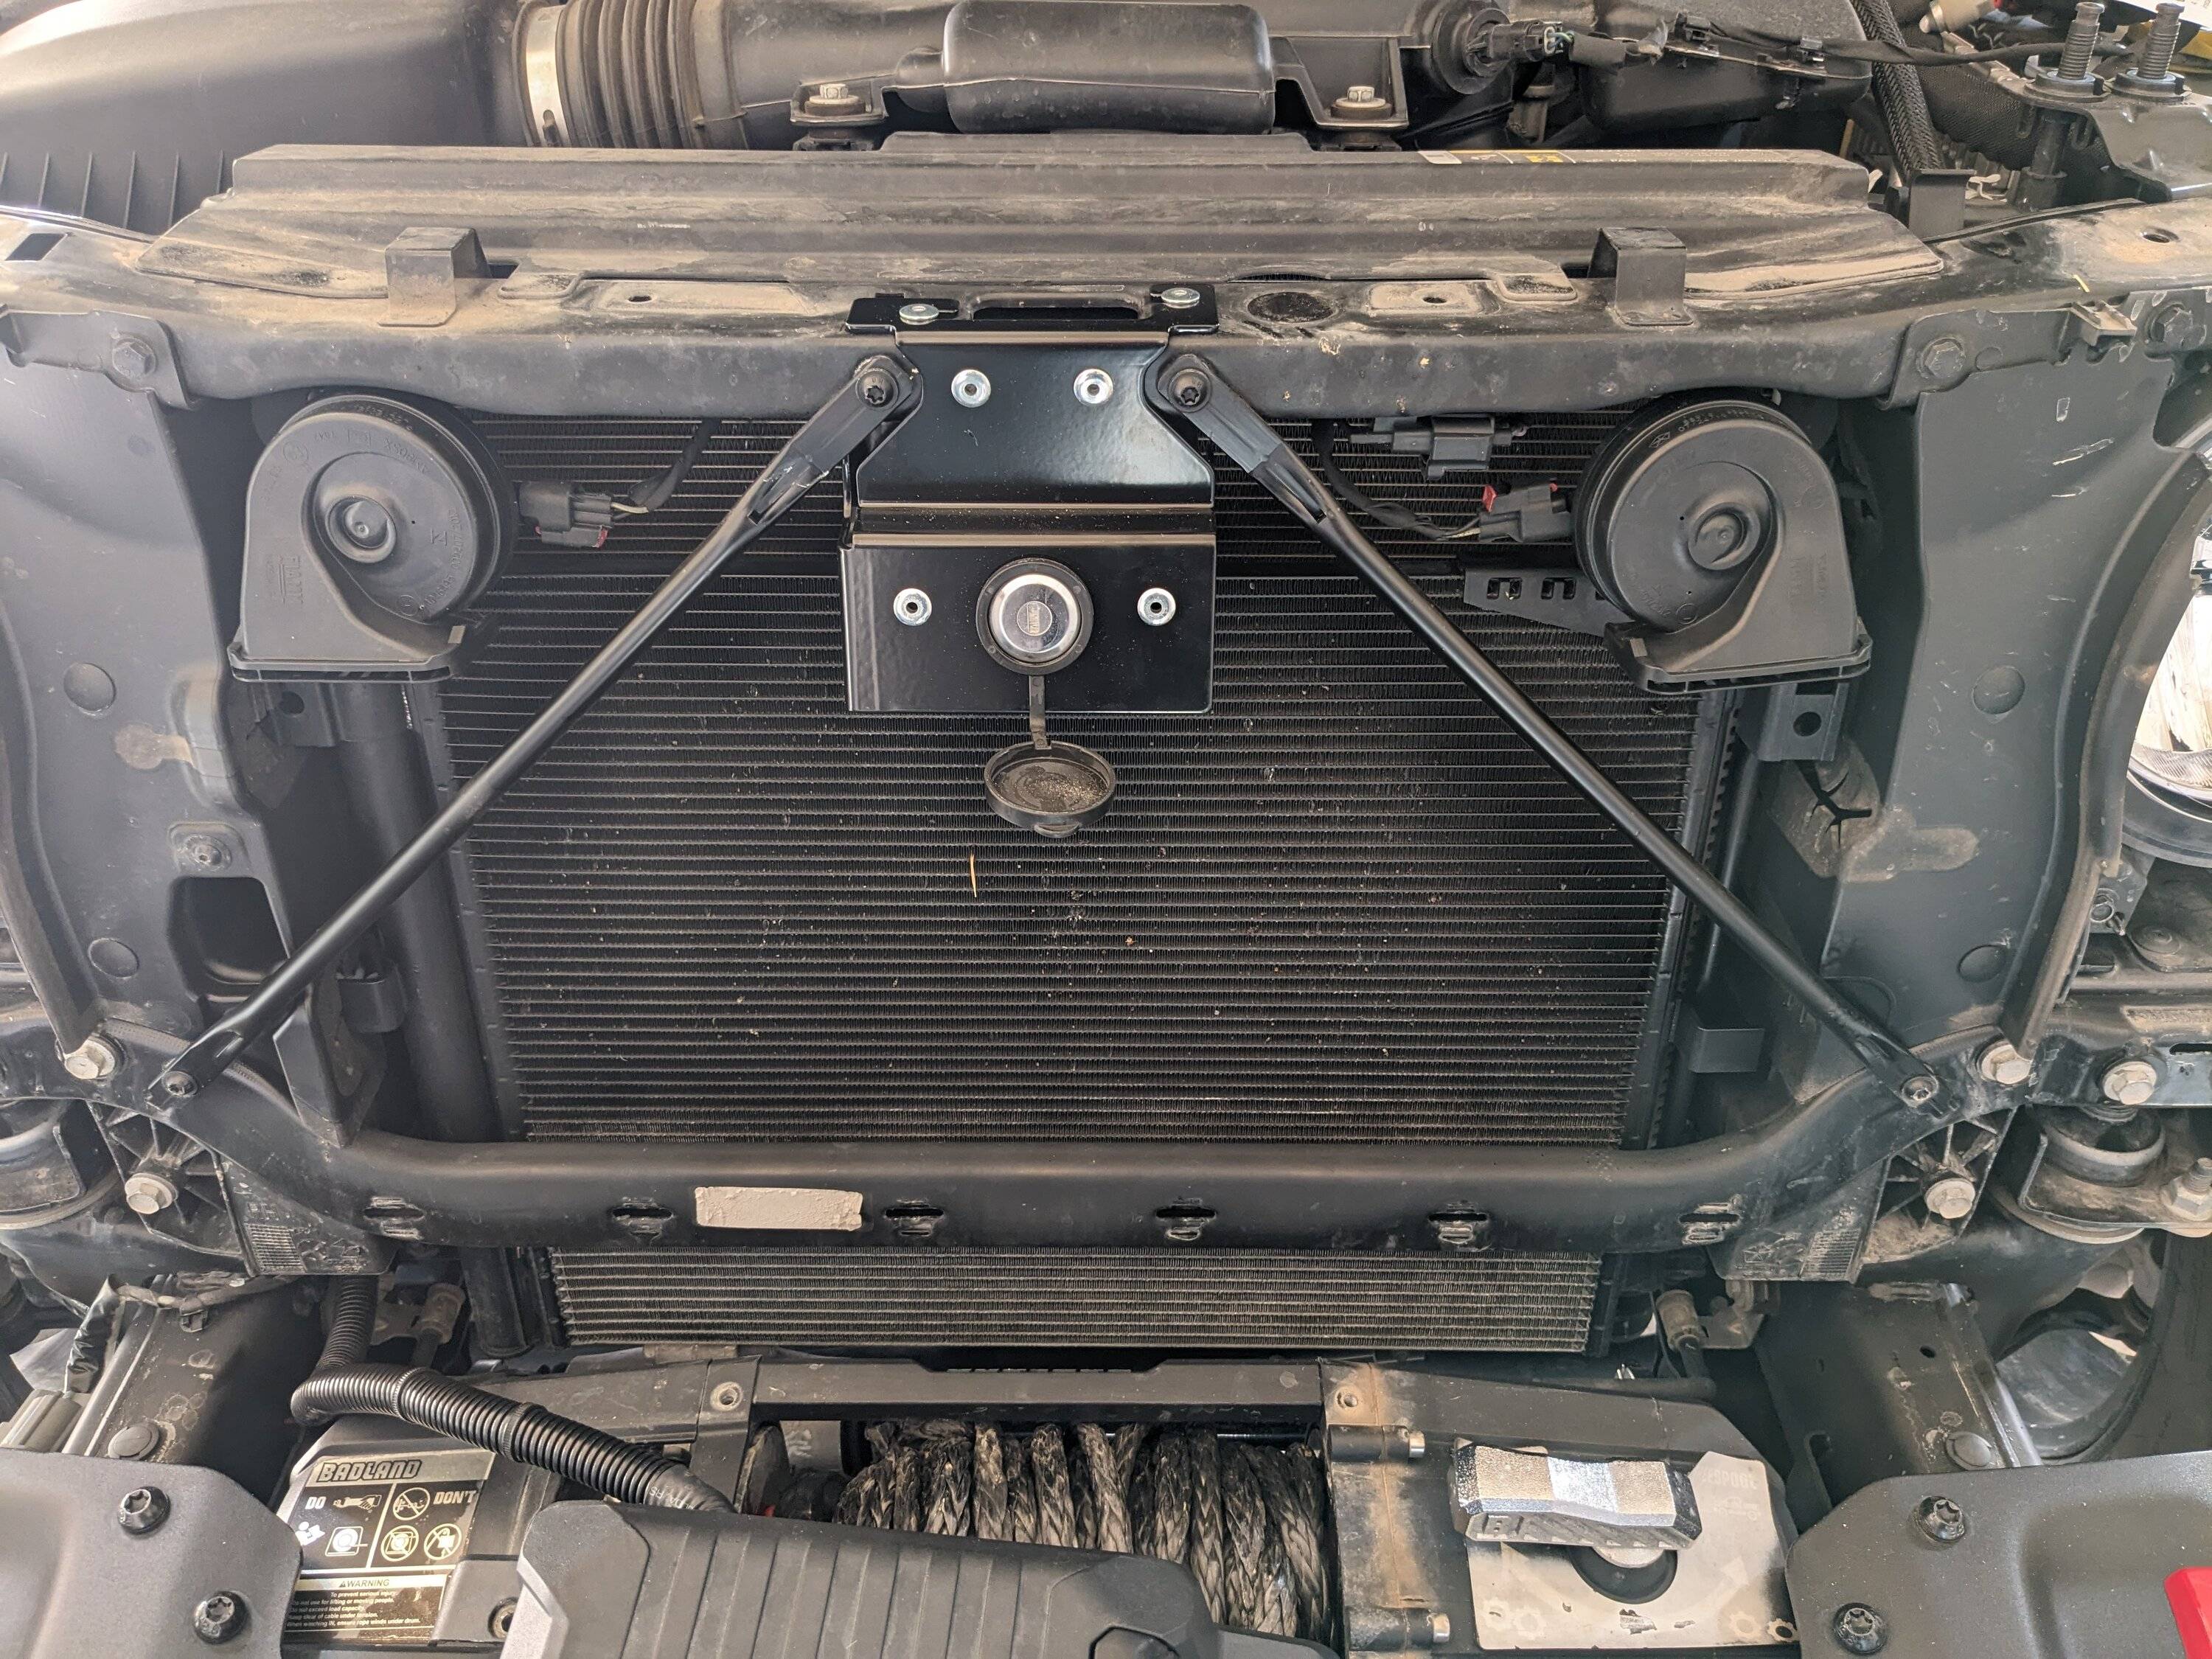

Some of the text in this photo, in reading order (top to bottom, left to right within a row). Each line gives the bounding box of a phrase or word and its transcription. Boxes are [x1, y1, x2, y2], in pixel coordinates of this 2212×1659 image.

[316, 1459, 422, 1482] BADLAND
[305, 1496, 327, 1509] DO
[433, 1490, 477, 1504] DON'T
[347, 1579, 389, 1587] WARNING
